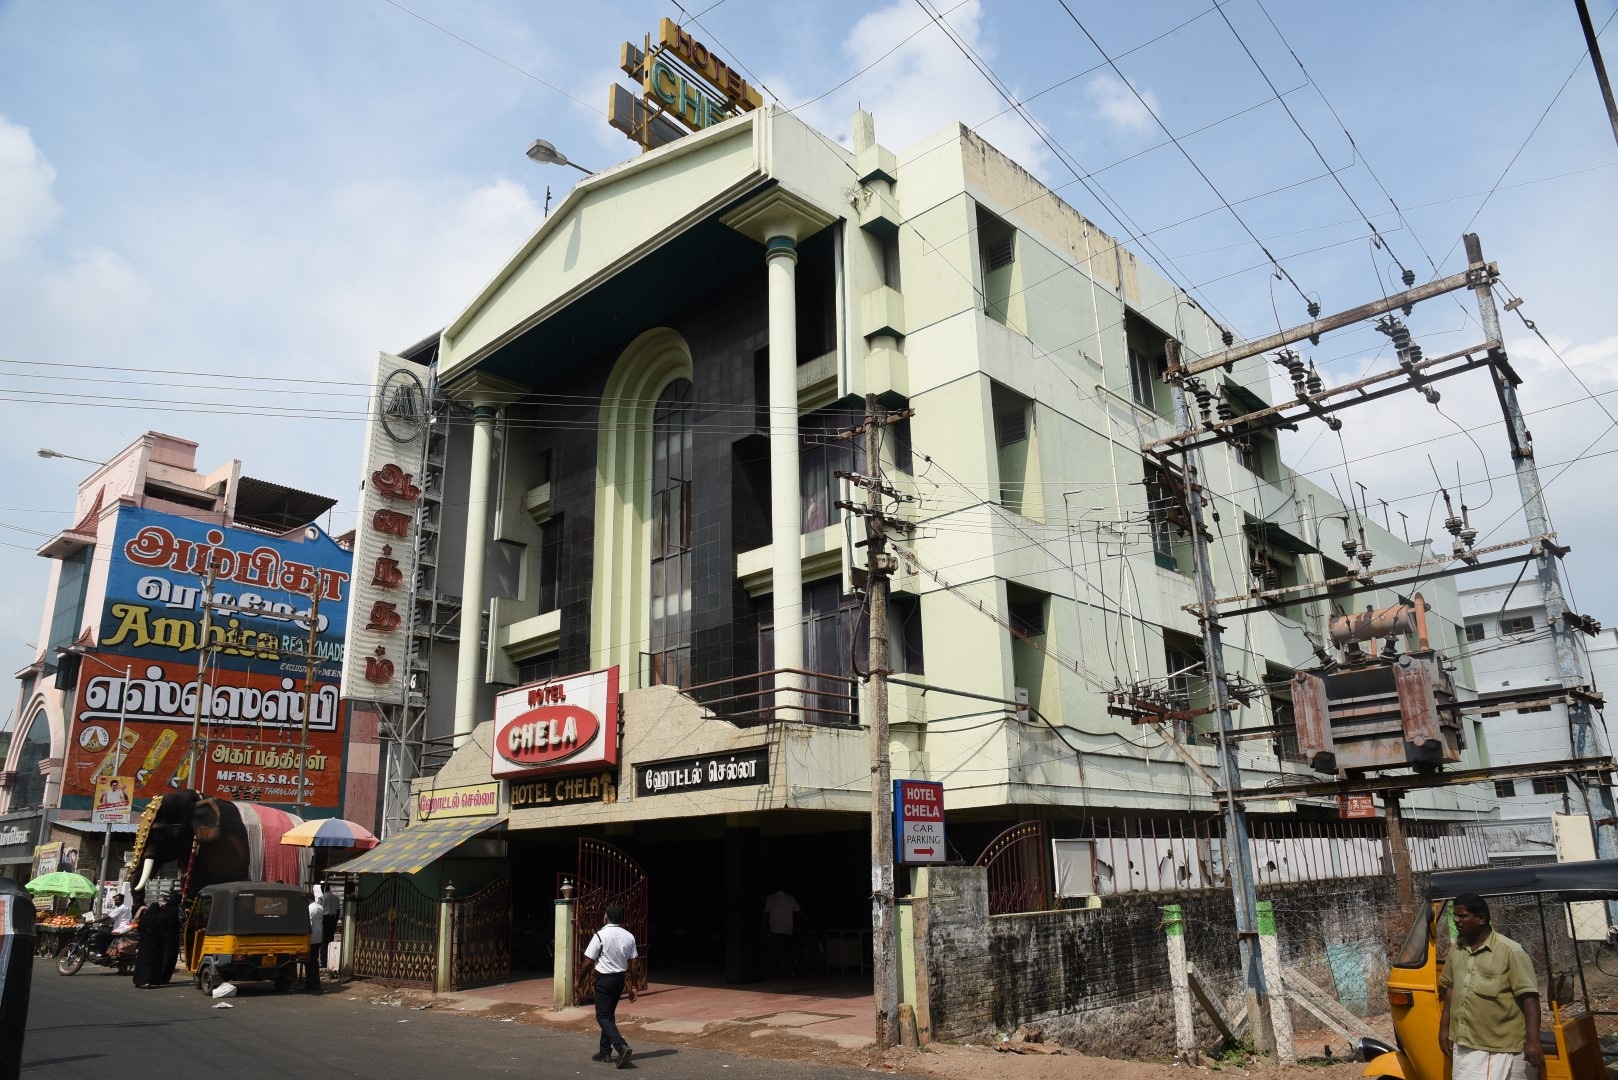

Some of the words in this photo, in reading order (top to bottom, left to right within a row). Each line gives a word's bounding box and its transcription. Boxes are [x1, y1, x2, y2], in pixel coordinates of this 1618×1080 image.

[674, 25, 756, 110] HOTEL
[652, 61, 733, 127] CHE
[124, 525, 349, 601] அம்பிகா
[101, 603, 281, 660] Ambica
[527, 684, 566, 706] HOTEL
[508, 716, 578, 752] CHELA
[216, 770, 256, 783] MFRS.
[645, 761, 703, 792] ஹோட்டல்
[708, 757, 757, 782] செல்லா
[419, 793, 460, 814] ஹோட்டல்
[461, 789, 496, 807] செல்லா
[511, 783, 550, 805] HOTEL
[555, 777, 599, 801] CHELA
[907, 788, 937, 801] HOTEL
[904, 804, 940, 817] CHELA
[906, 835, 941, 845] PARKING
[912, 823, 934, 833] CAR
